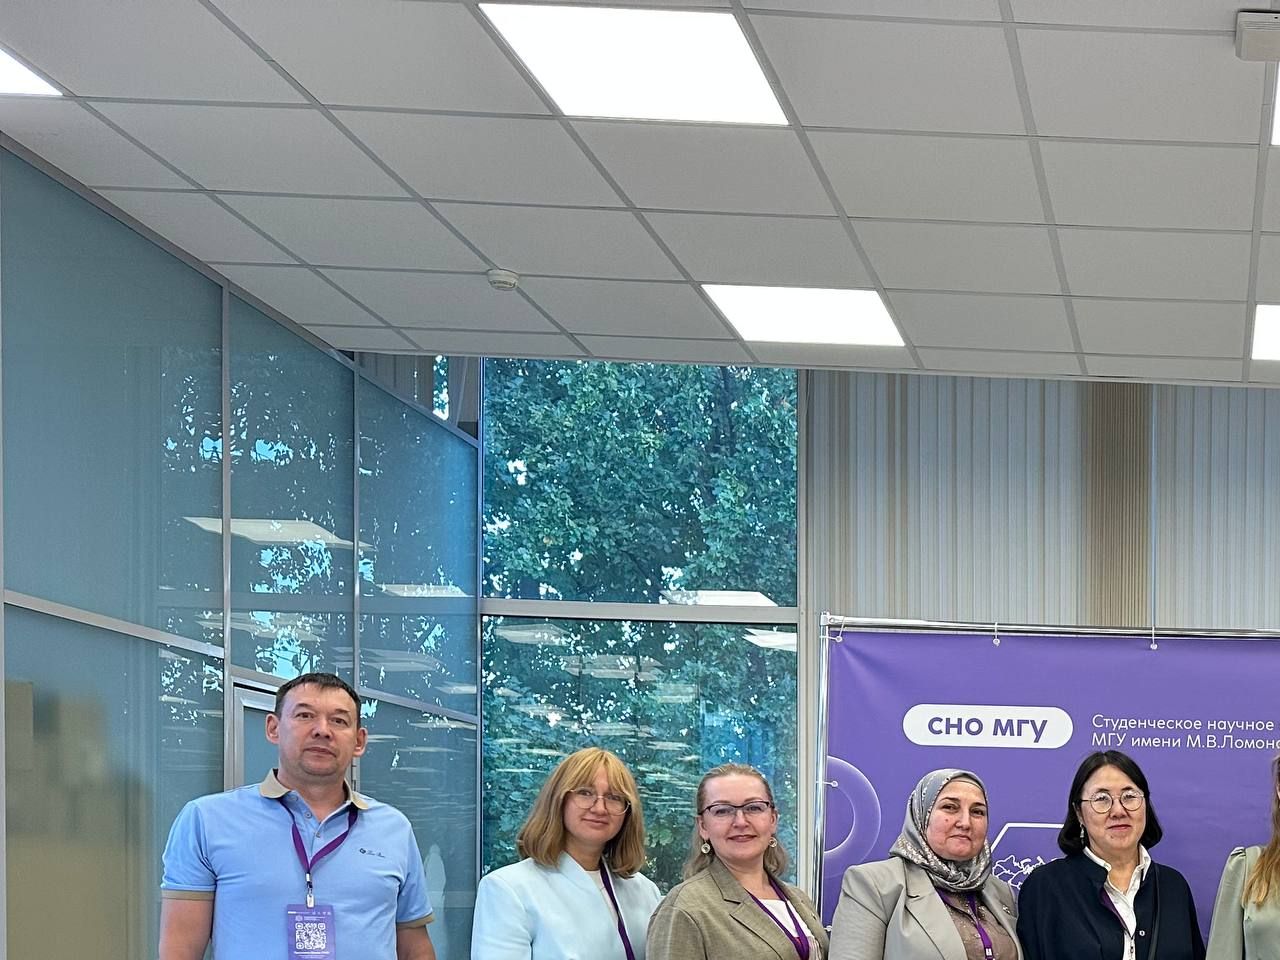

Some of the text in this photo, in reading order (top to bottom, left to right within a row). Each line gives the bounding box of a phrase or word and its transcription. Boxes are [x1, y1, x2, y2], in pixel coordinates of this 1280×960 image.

[1092, 714, 1202, 731] Студенческое
[1207, 719, 1275, 733] научное
[1092, 732, 1127, 747] МГУ
[1131, 736, 1181, 748] имени
